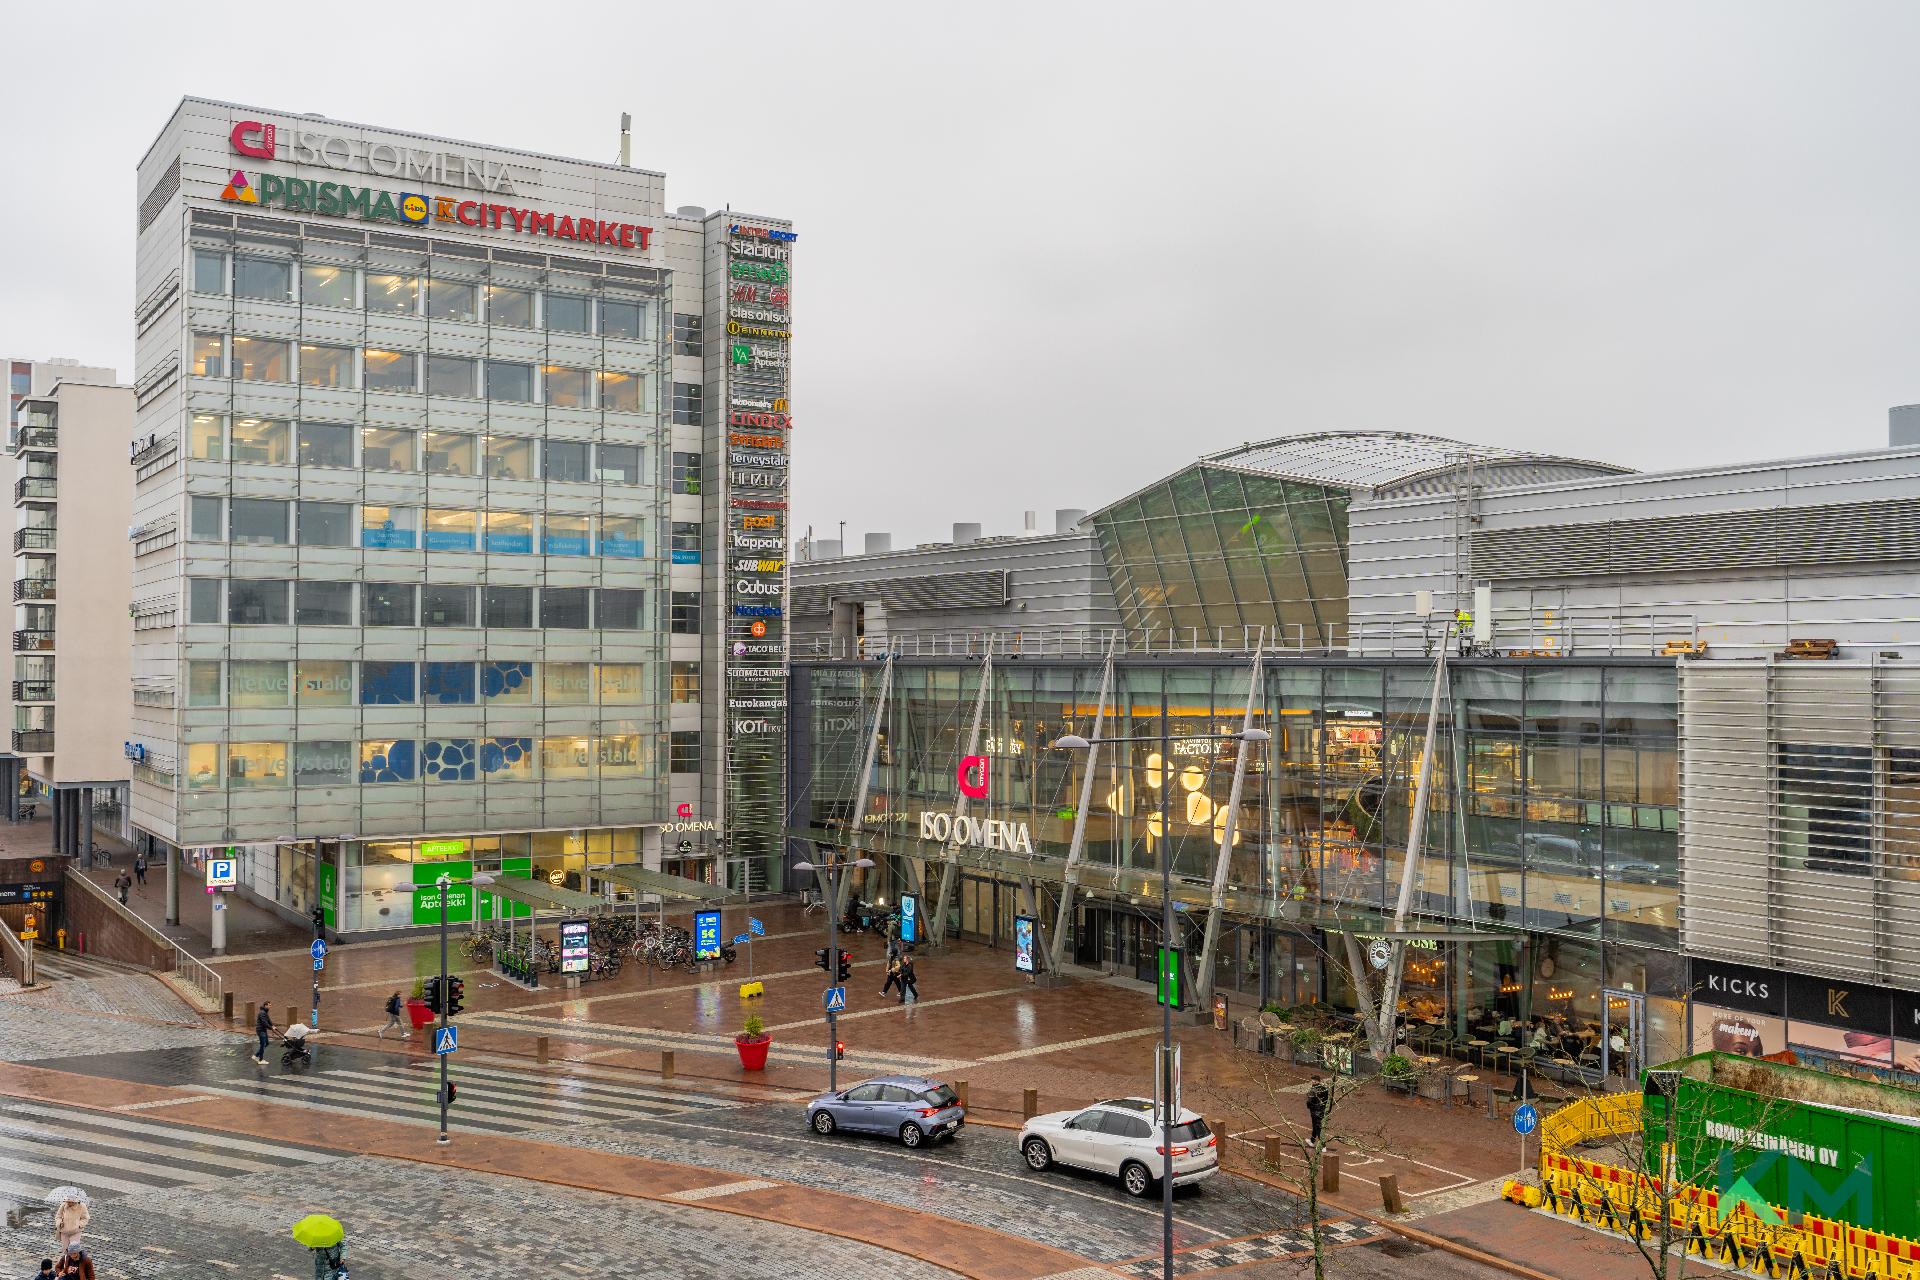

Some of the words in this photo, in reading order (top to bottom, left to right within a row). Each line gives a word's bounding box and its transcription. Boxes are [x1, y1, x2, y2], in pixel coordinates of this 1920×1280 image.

[289, 129, 354, 169] ISO
[369, 143, 518, 197] OMENA
[260, 173, 399, 221] PRISMA
[457, 200, 654, 250] CITYMARKET
[739, 224, 798, 242] INTERSPORT
[730, 240, 789, 260] stadium
[730, 307, 754, 319] clas
[735, 347, 747, 361] YA
[731, 398, 772, 409] McDonald's
[731, 411, 793, 429] LINDEX
[731, 452, 789, 466] Terveystalo
[743, 513, 775, 530] posti
[735, 559, 785, 573] SUBWAY
[736, 579, 780, 594] Cubus
[747, 645, 768, 653] TACO
[769, 645, 786, 653] BELL
[727, 669, 790, 677] SUOMALAINEN
[729, 698, 788, 709] Eurokangas
[676, 821, 713, 832] OMENA
[920, 811, 952, 842] ISO
[954, 815, 1032, 854] OMENA
[1709, 974, 1769, 999] KICKS
[1828, 988, 1849, 1018] K
[1734, 1014, 1744, 1022] OF
[1746, 1016, 1766, 1027] YOUR
[1718, 1022, 1760, 1042] makeup
[1819, 1147, 1838, 1167] OY
